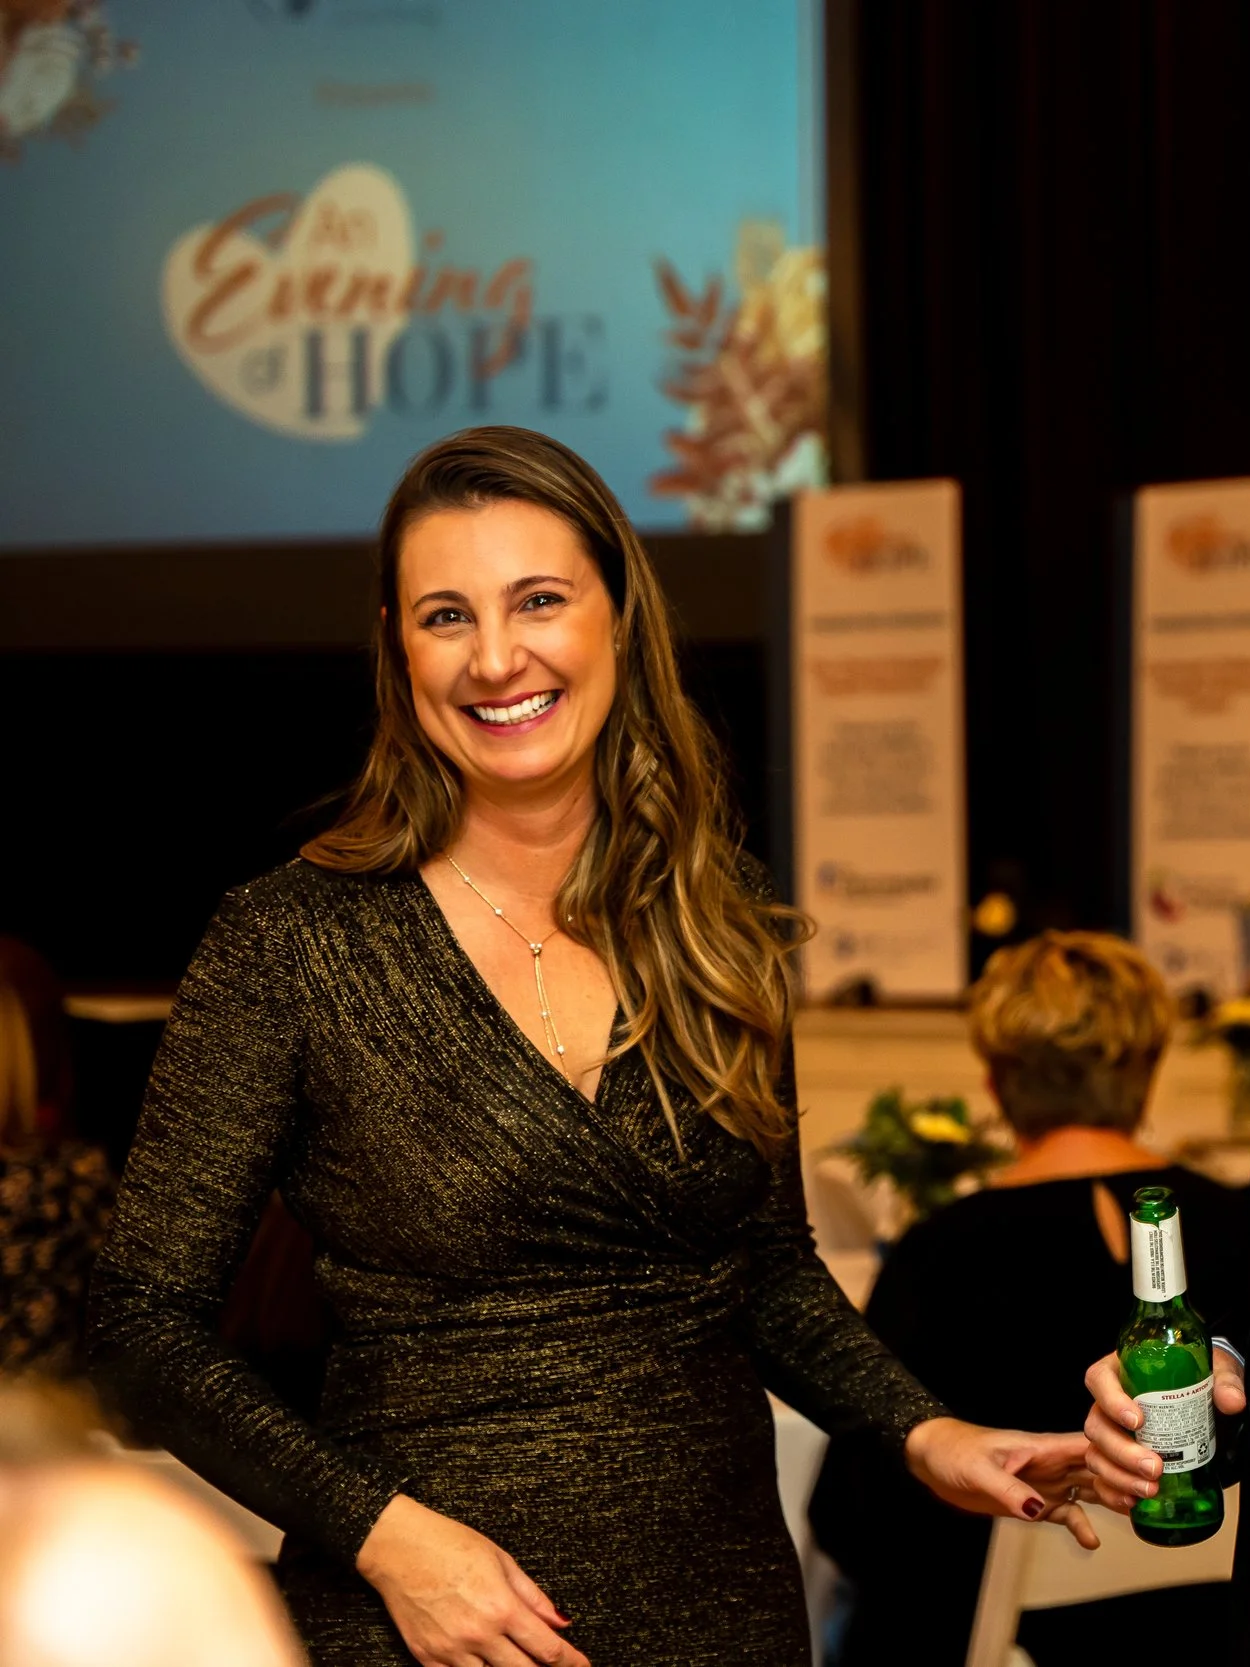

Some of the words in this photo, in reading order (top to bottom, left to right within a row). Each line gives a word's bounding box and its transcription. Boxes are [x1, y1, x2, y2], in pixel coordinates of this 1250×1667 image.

[186, 190, 534, 380] Evening
[303, 317, 607, 419] HOPE
[1191, 1383, 1209, 1395] ARTOIS
